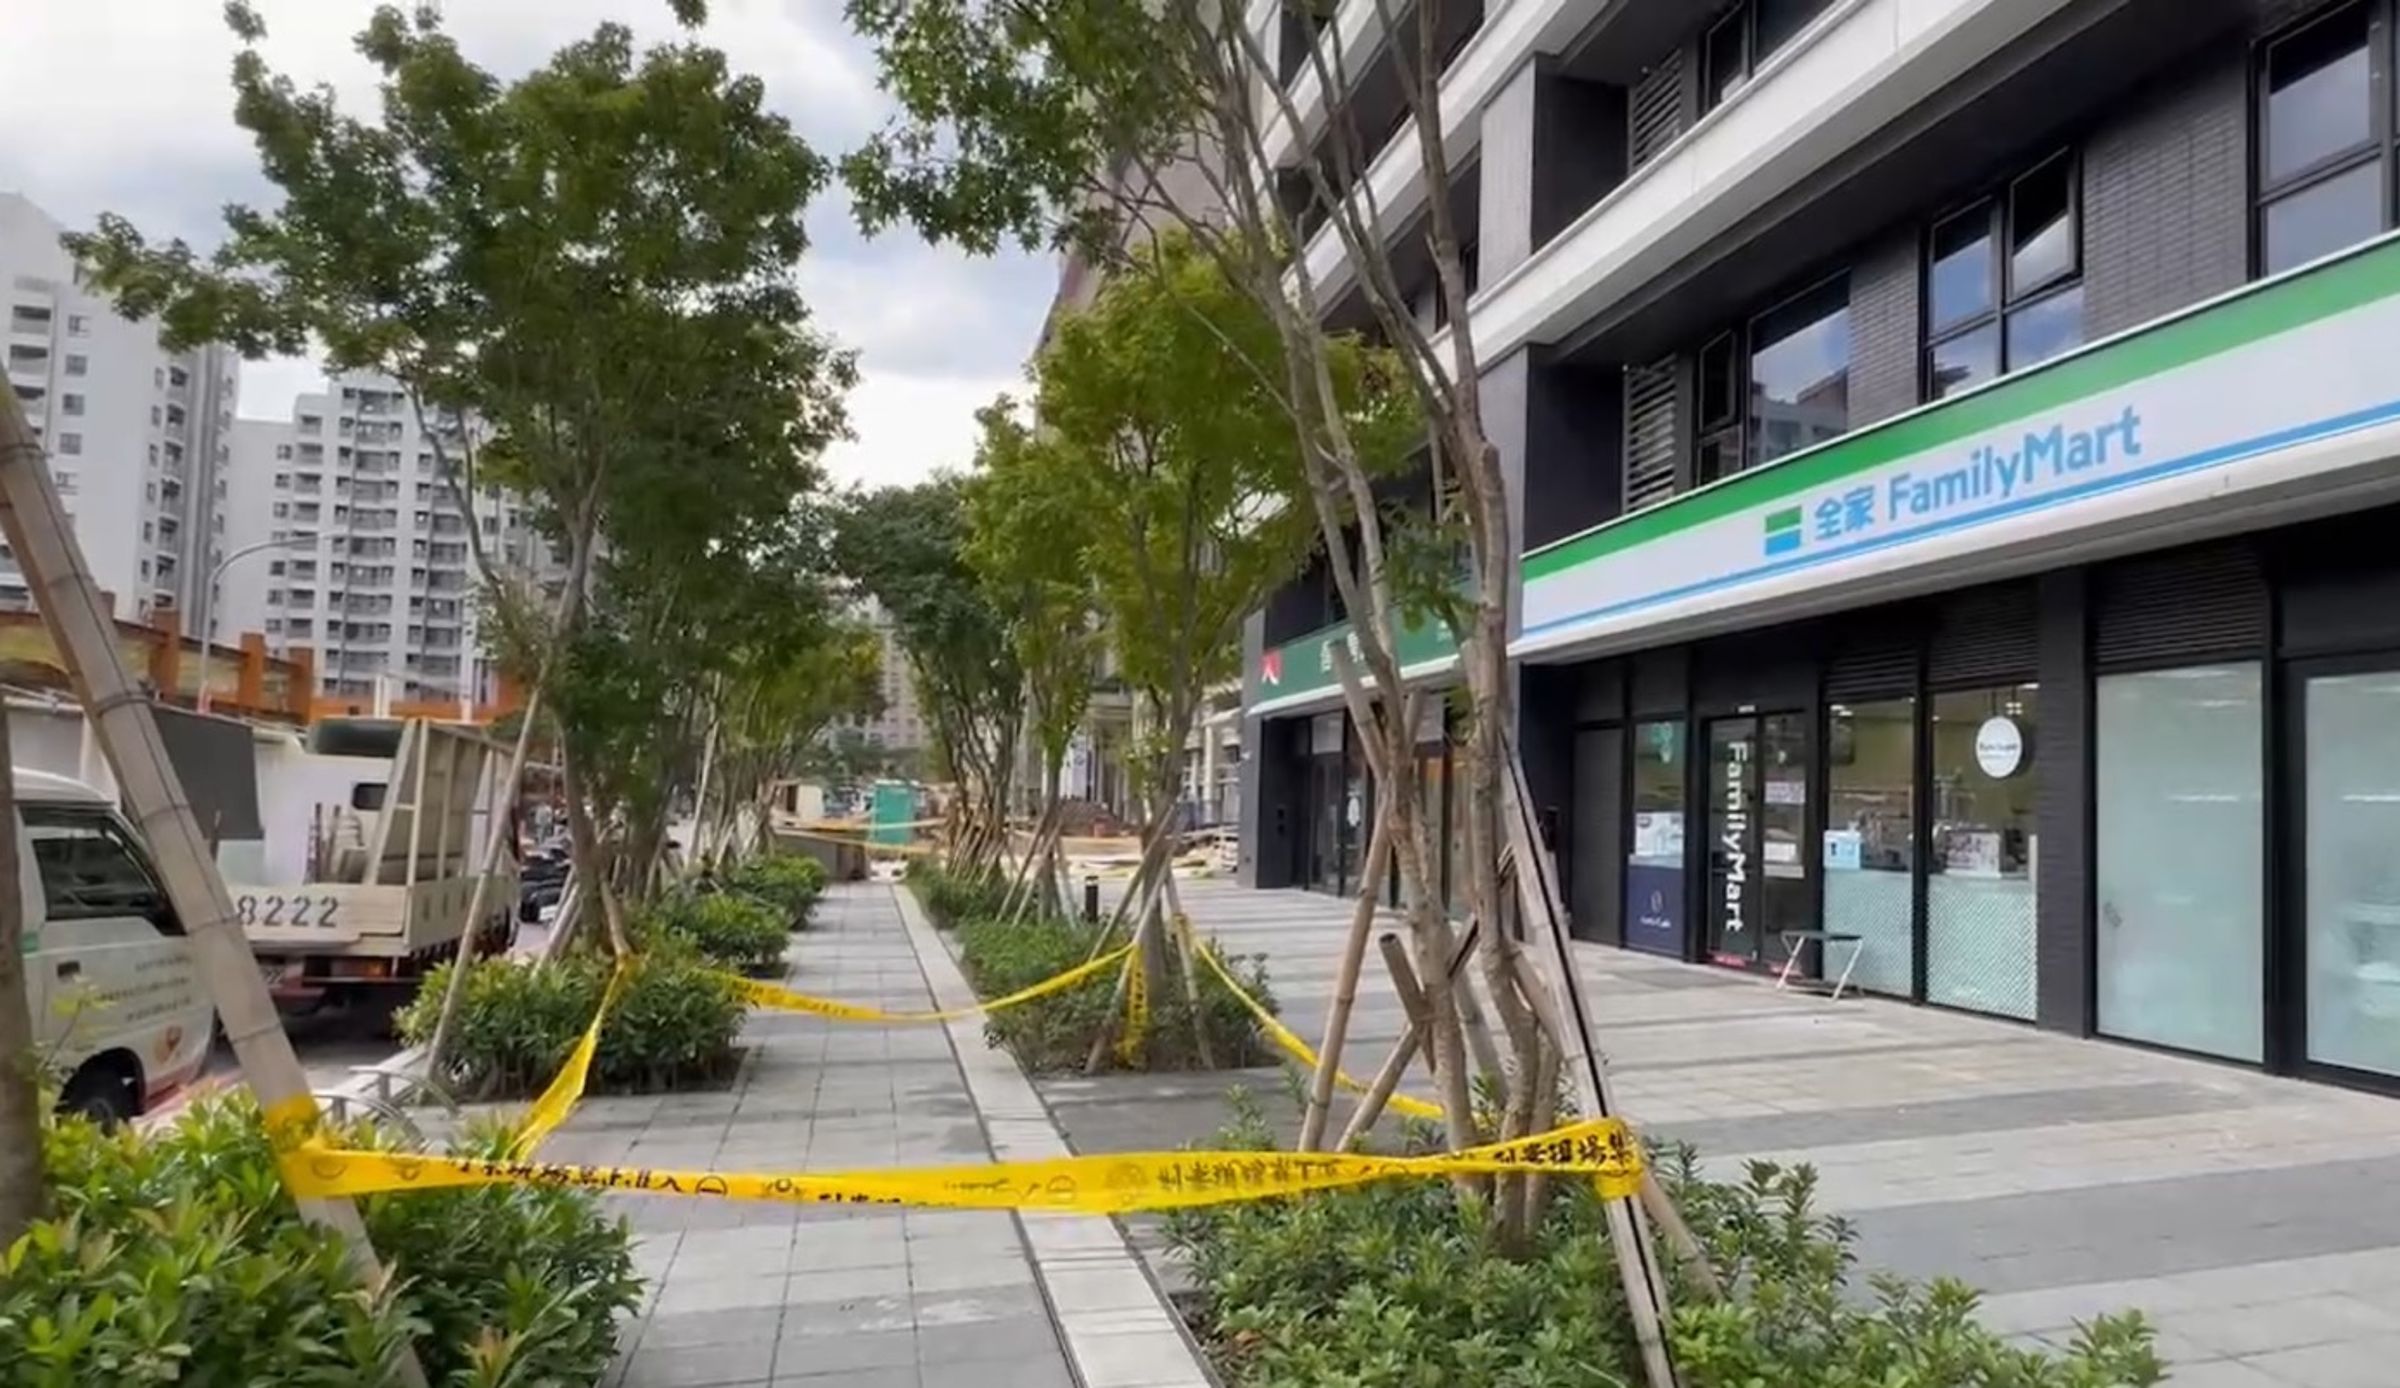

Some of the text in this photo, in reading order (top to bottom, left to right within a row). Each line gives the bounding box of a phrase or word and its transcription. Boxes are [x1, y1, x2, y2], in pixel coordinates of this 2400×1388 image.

[1814, 405, 2142, 541] 全家 FamilyMart
[1721, 741, 1748, 933] FamilyMart
[237, 894, 339, 929] 8222
